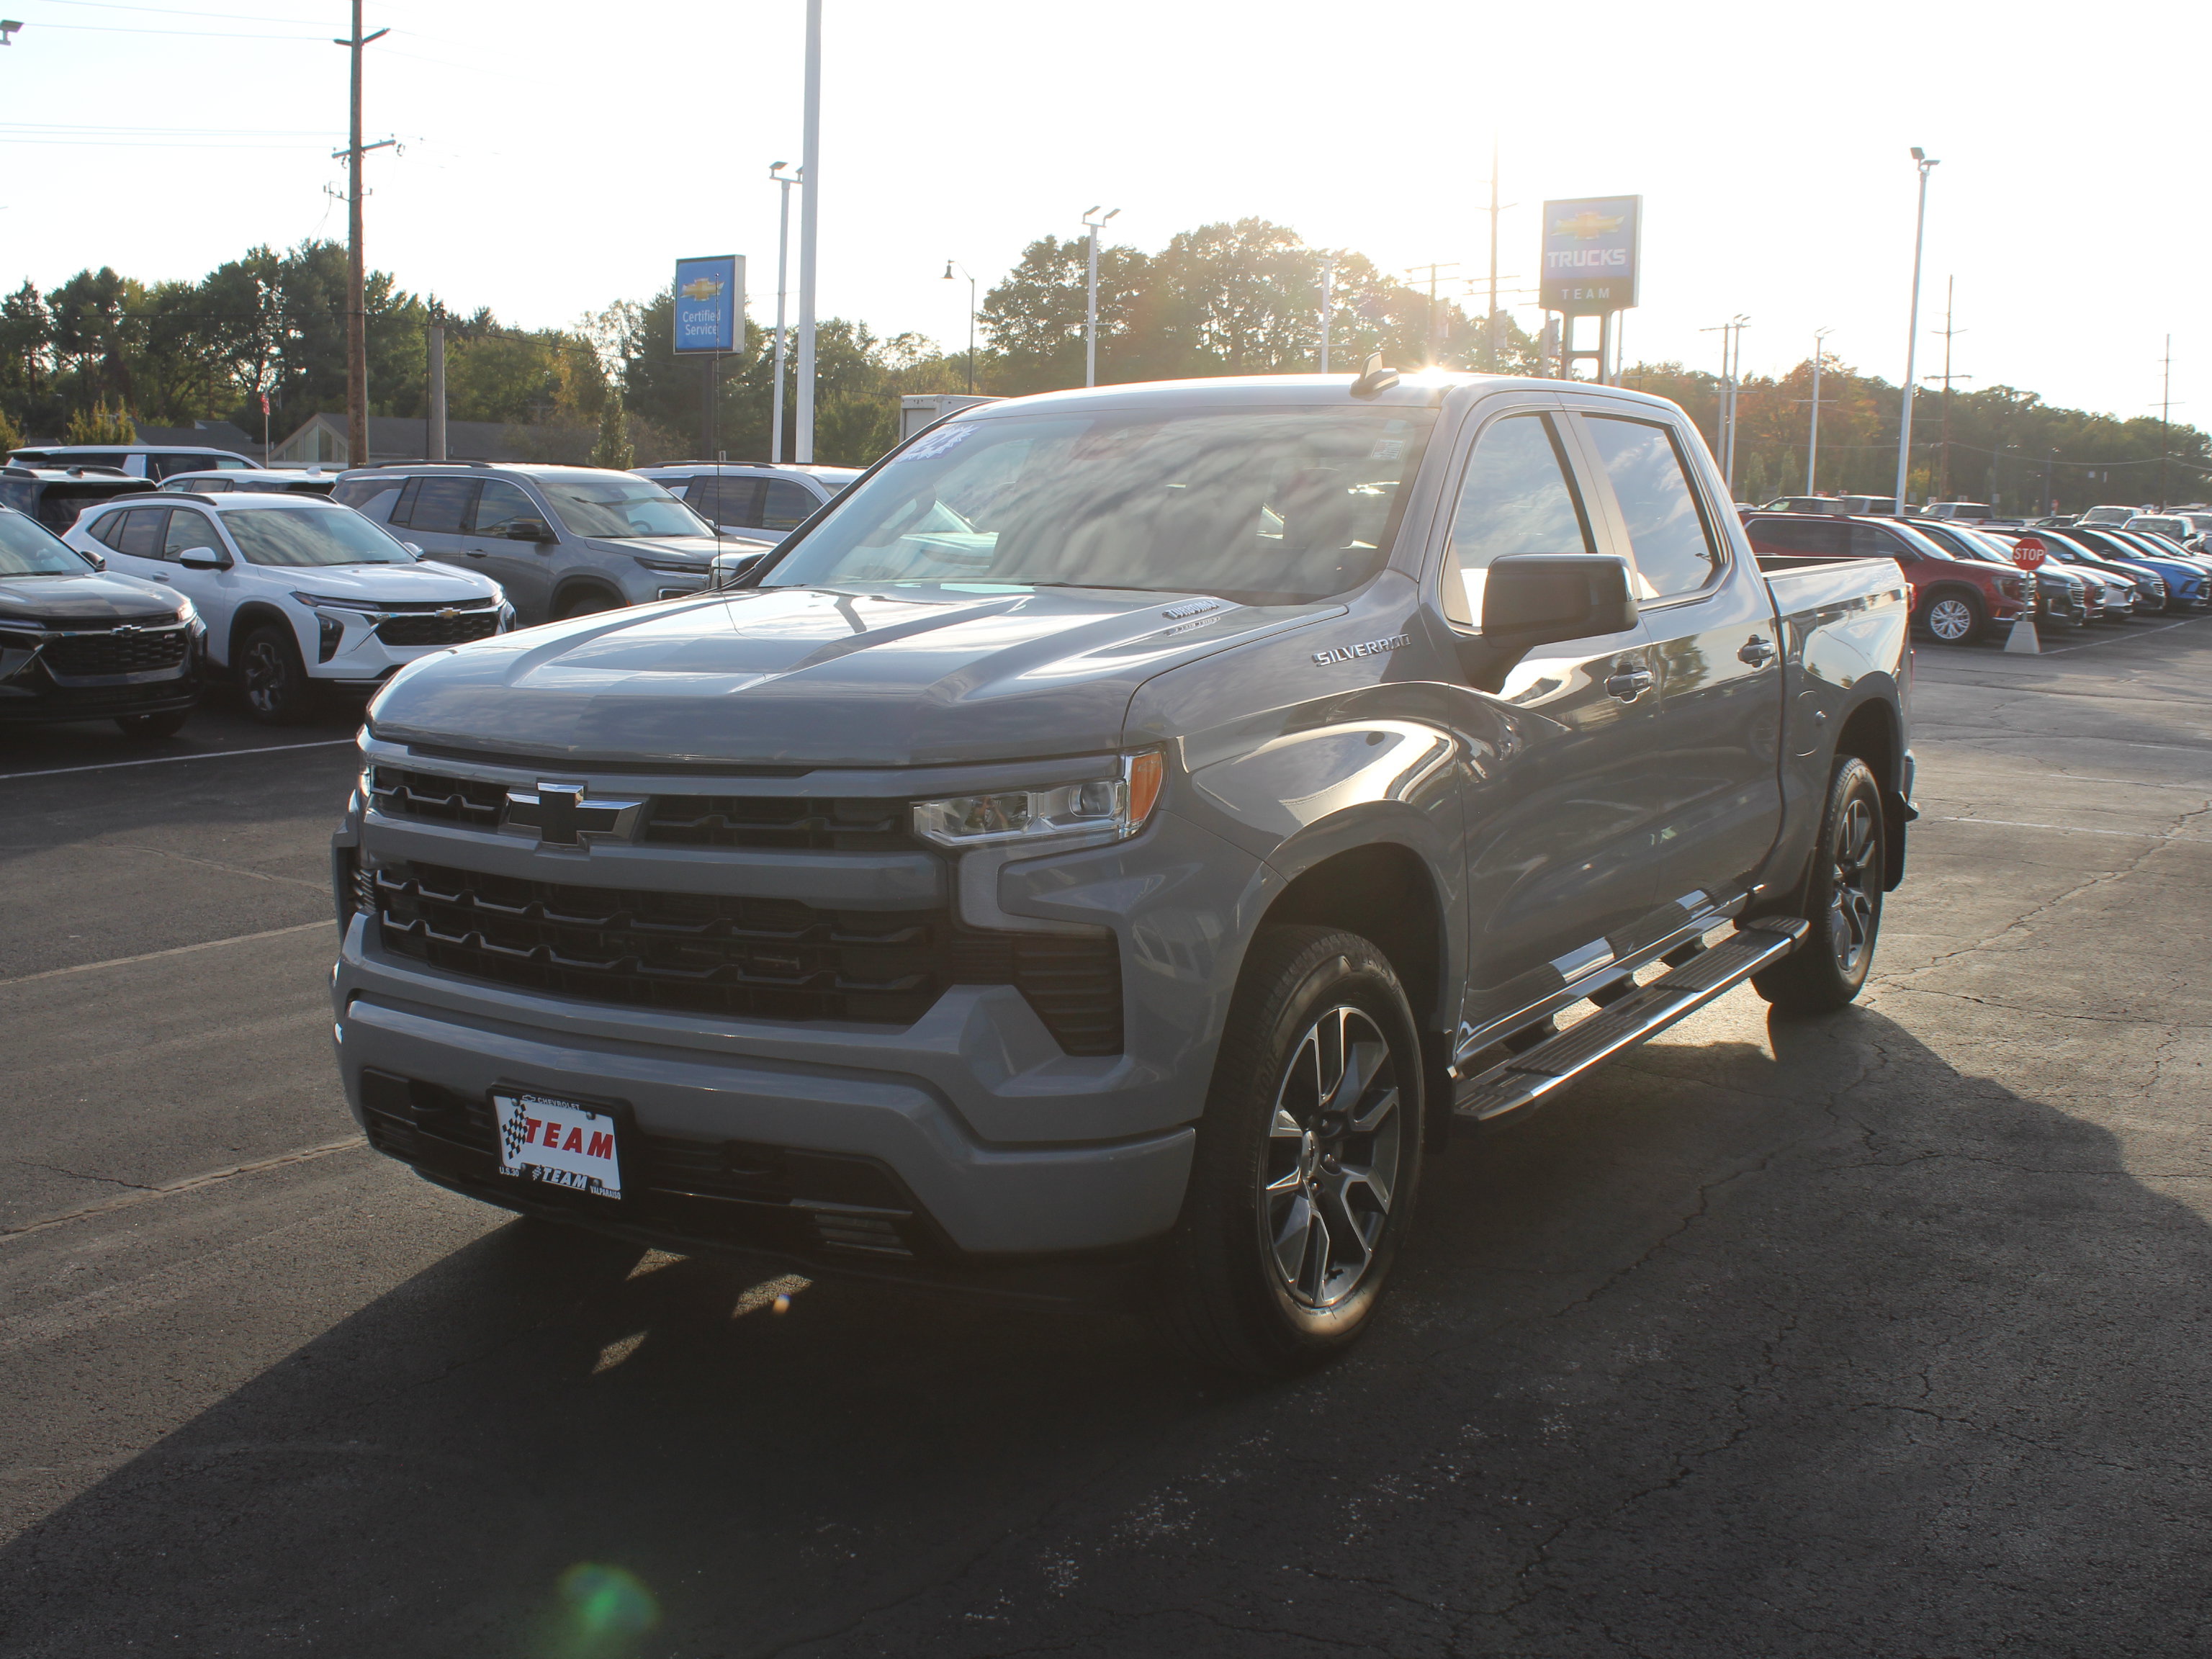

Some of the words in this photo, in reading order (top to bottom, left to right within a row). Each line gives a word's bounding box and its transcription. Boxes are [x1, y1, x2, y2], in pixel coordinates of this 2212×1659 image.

[1547, 248, 1626, 268] TRUCKS
[1561, 288, 1610, 300] TEAM
[683, 310, 721, 323] Certified
[685, 323, 717, 336] Service
[2014, 548, 2045, 561] STOP
[1162, 599, 1220, 620] TURBOMAX
[537, 1097, 580, 1110] CHEVROLET
[525, 1118, 613, 1160] TEAM
[542, 1166, 588, 1190] TEAM
[590, 1185, 621, 1200] VALPARAISO
